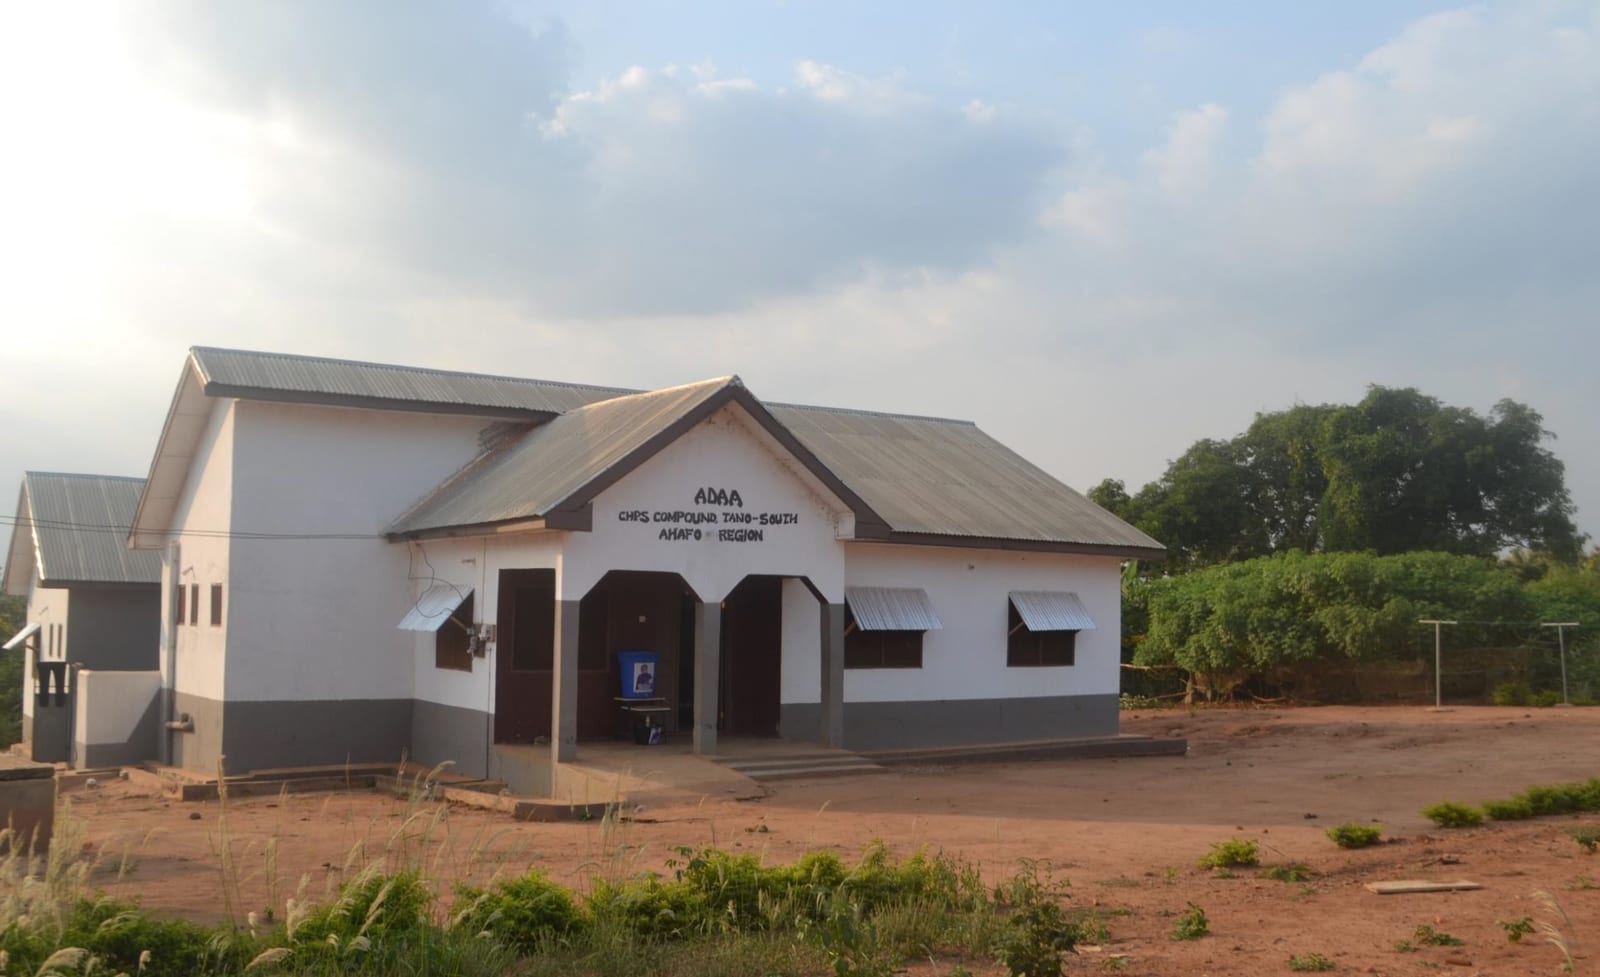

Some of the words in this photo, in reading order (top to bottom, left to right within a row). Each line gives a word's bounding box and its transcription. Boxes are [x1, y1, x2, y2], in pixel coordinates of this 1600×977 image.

[694, 487, 743, 507] ADAA
[618, 510, 650, 523] CHPS
[722, 512, 799, 525] TANO-SOUTH
[658, 527, 702, 541] AHAFO
[718, 529, 763, 542] REGION
